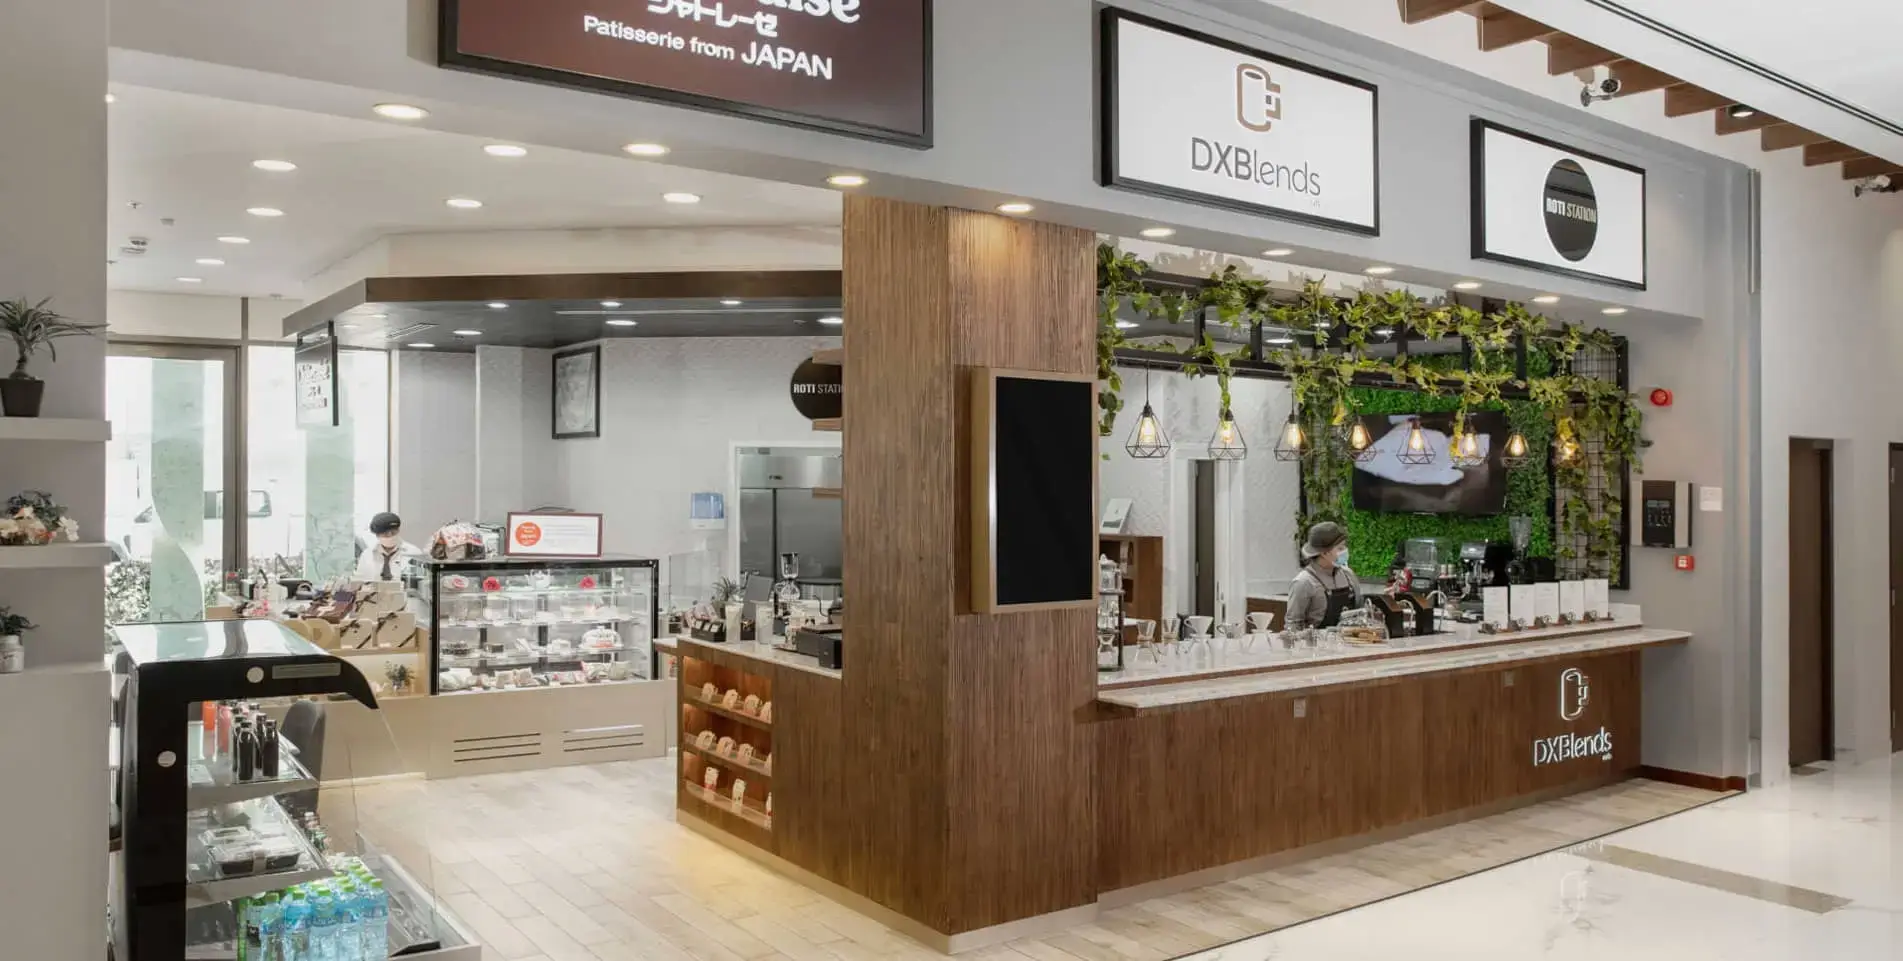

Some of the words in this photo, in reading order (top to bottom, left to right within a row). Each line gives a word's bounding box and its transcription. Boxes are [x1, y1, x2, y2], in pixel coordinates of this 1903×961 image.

[584, 15, 685, 50] Patisserie
[690, 37, 735, 60] from
[741, 41, 833, 80] JAPAN
[1191, 136, 1321, 197] DXBlends
[1546, 197, 1566, 216] ROTI
[1566, 202, 1597, 224] STATION
[793, 383, 816, 394] ROTI
[817, 383, 844, 394] STATI
[1534, 726, 1612, 766] DXBlends
